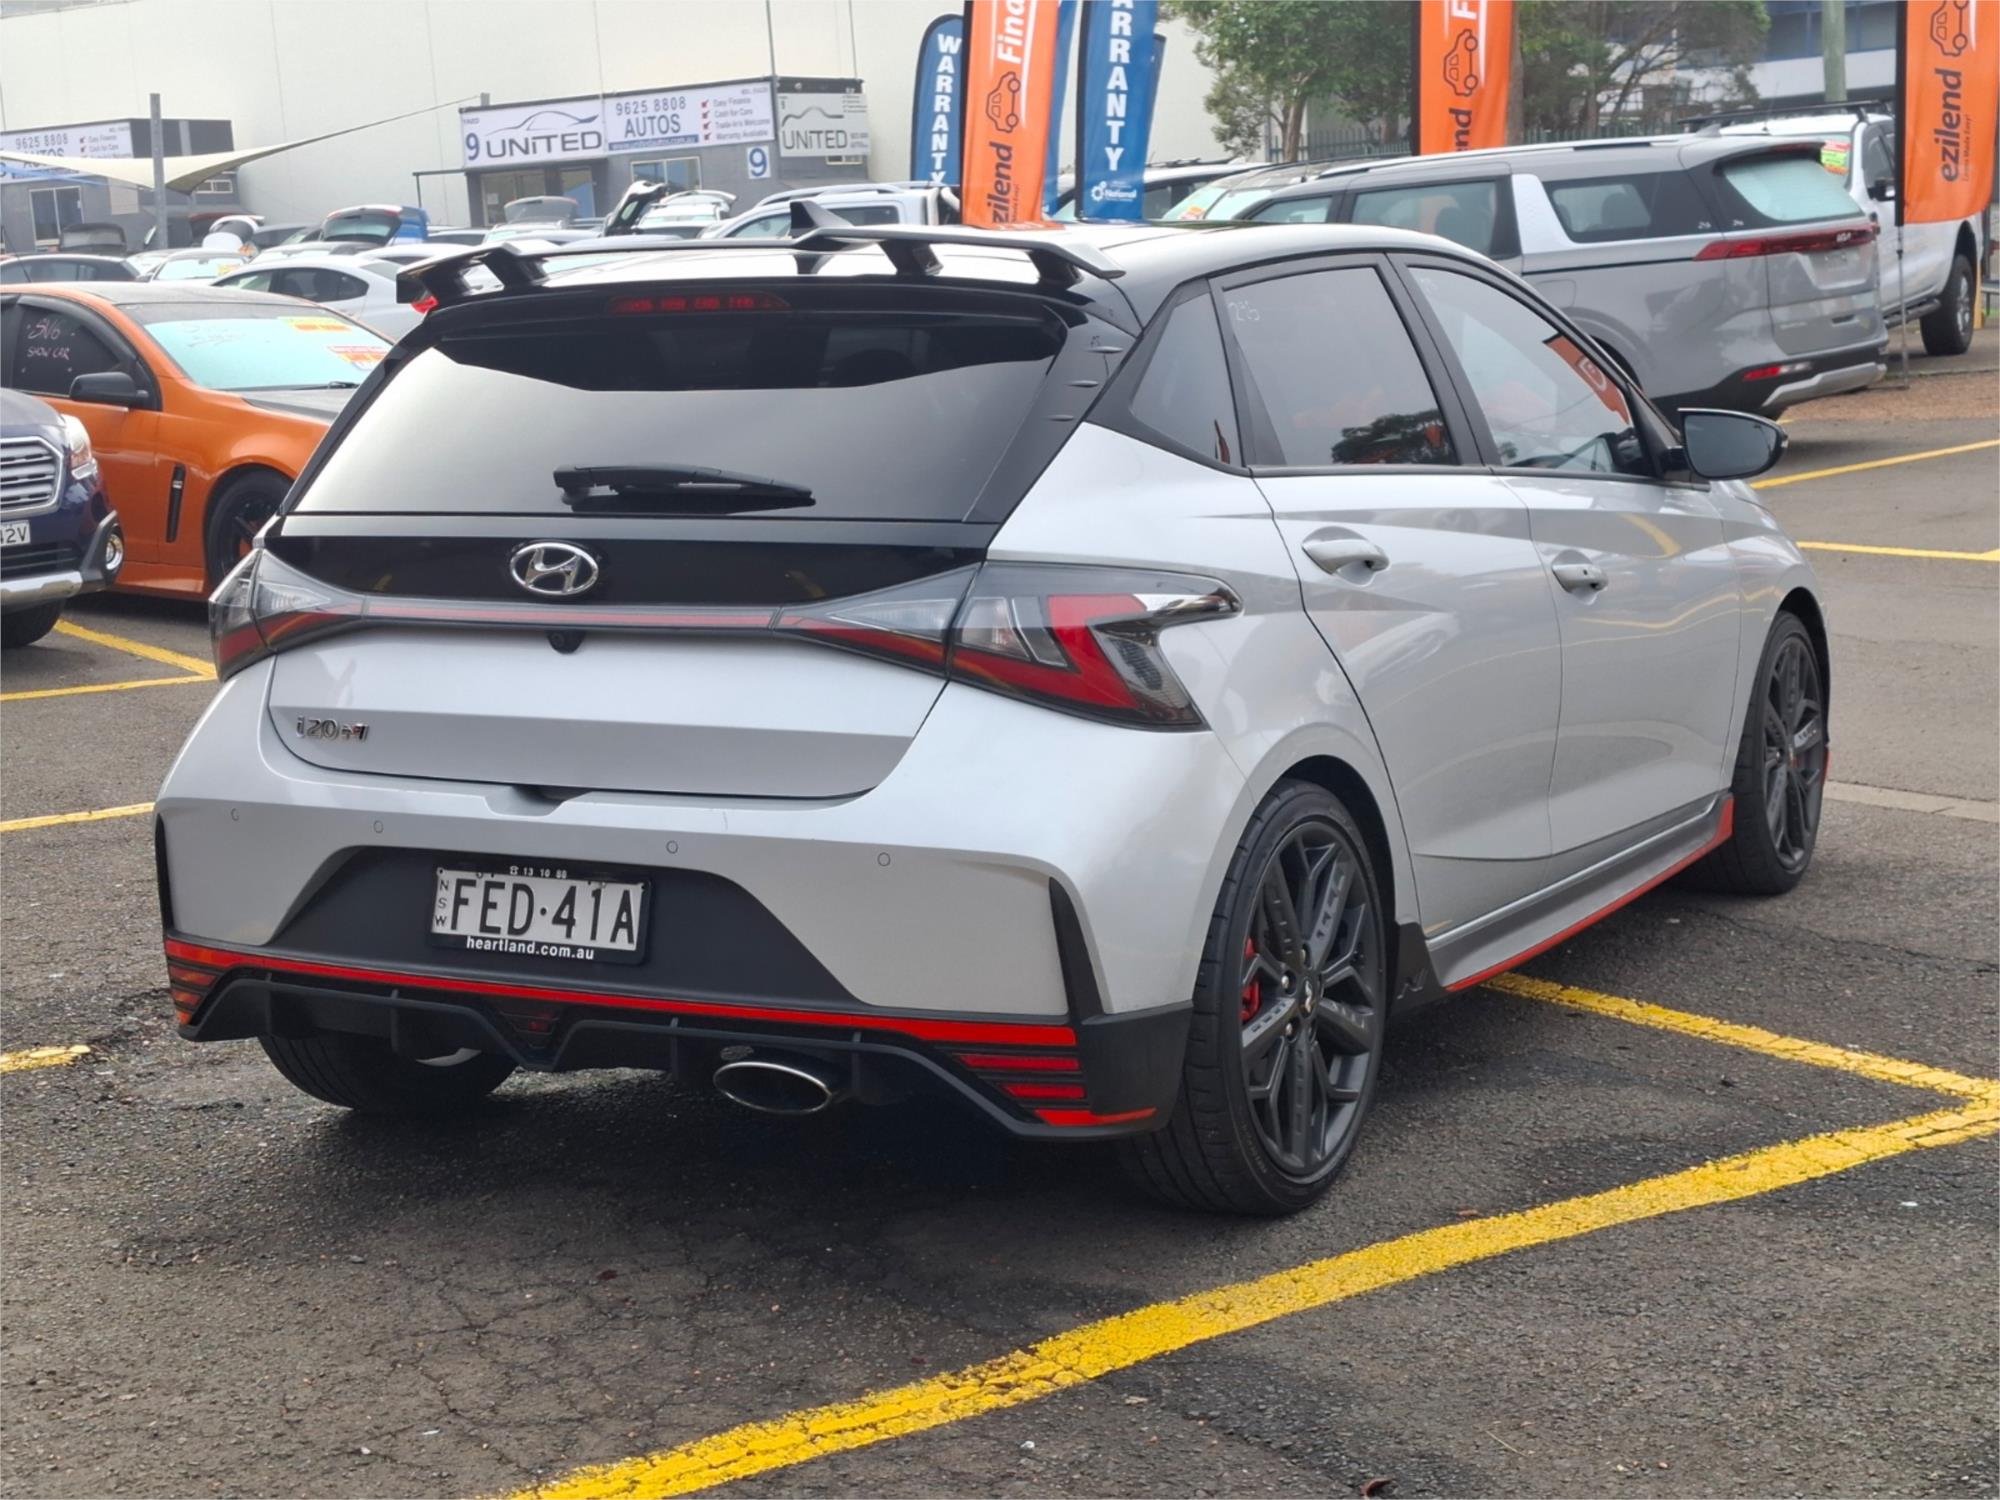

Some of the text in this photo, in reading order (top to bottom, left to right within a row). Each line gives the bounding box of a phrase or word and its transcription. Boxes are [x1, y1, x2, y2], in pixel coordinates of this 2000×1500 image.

[616, 96, 686, 116] 9625 8808
[930, 33, 962, 186] WARRANTY
[624, 114, 681, 138] AUTOS
[1448, 108, 1473, 152] nd
[1934, 68, 1962, 182] ezilend
[15, 135, 40, 150] 9625
[465, 133, 480, 160] 9
[749, 148, 767, 177] 9
[466, 936, 595, 960] heartland.com.au
